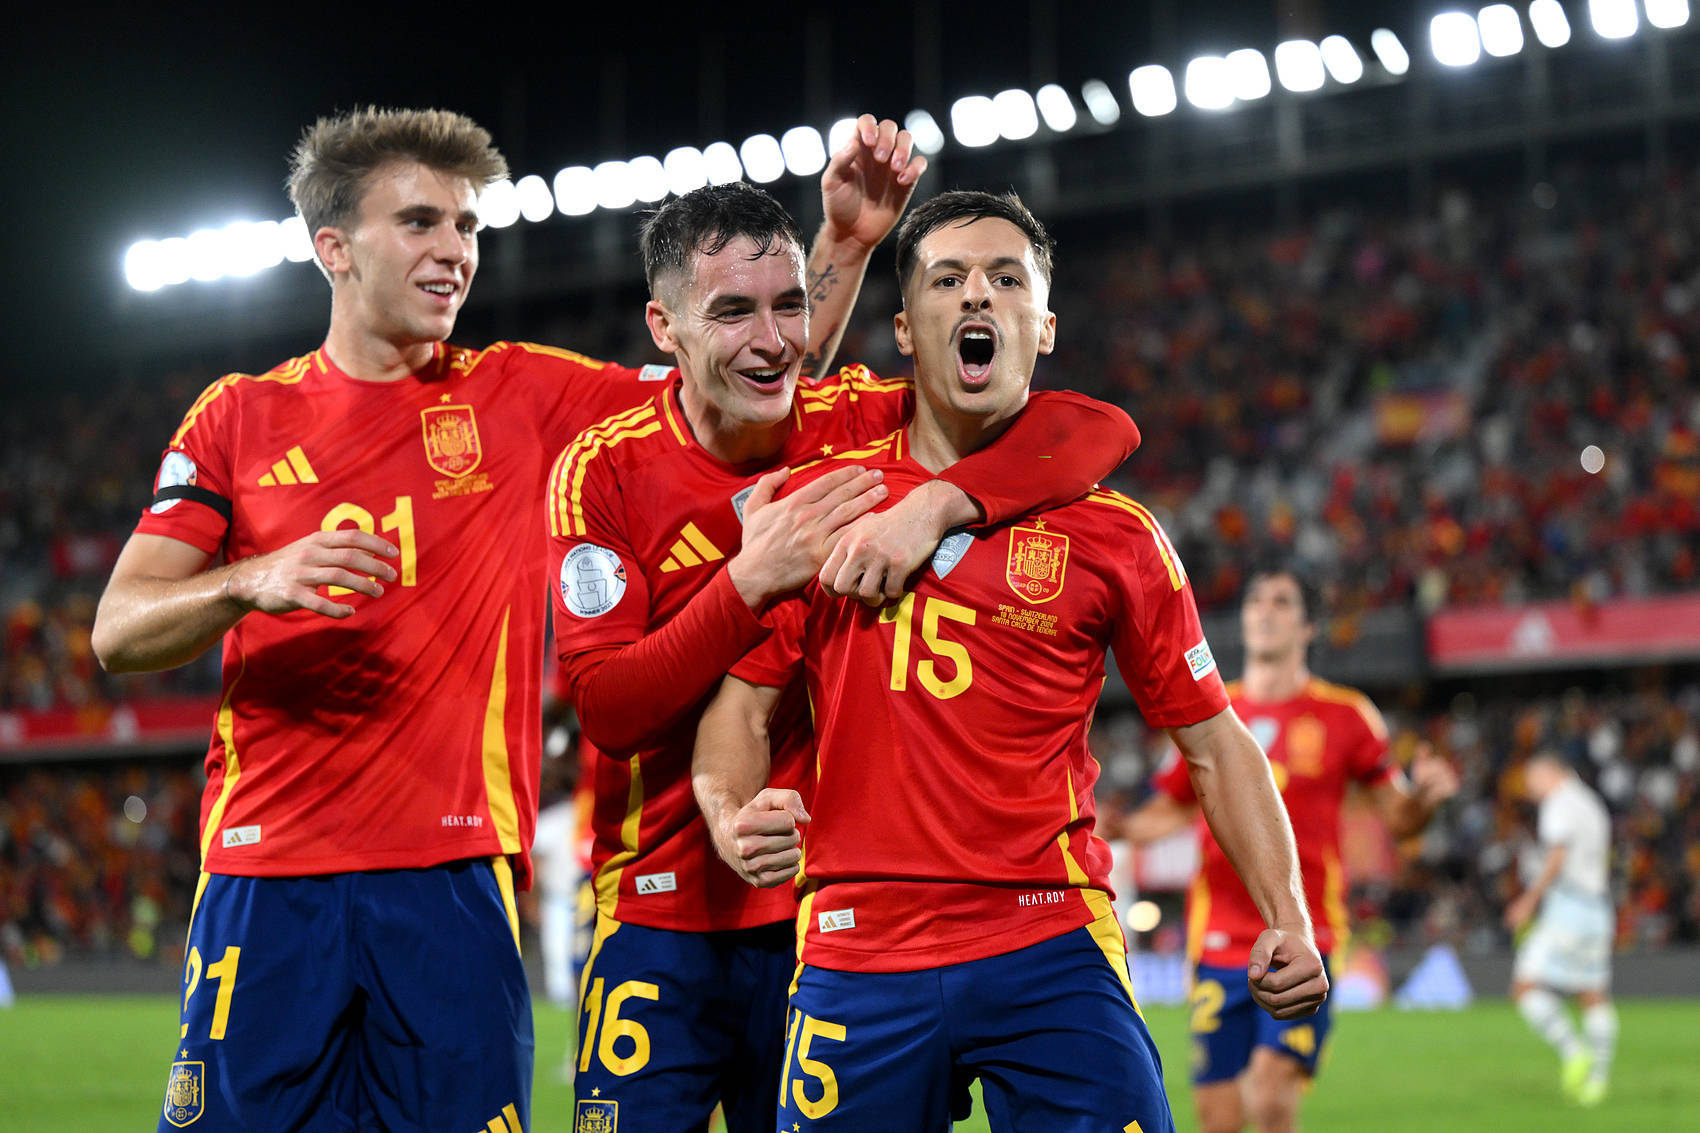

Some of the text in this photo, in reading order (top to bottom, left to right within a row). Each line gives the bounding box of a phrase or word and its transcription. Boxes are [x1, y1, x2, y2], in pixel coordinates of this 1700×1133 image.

[998, 604, 1016, 613] SPAIN
[1021, 609, 1058, 623] SWITZERLAND
[1008, 613, 1040, 626] NOVEMBER
[991, 615, 1010, 626] SANTA
[1011, 620, 1027, 630] CRUZ
[879, 591, 977, 700] 15
[441, 814, 483, 828] HEAT.RDY
[1018, 891, 1065, 907] HEAT.RDY
[579, 977, 659, 1077] 16
[780, 1008, 847, 1120] 15
